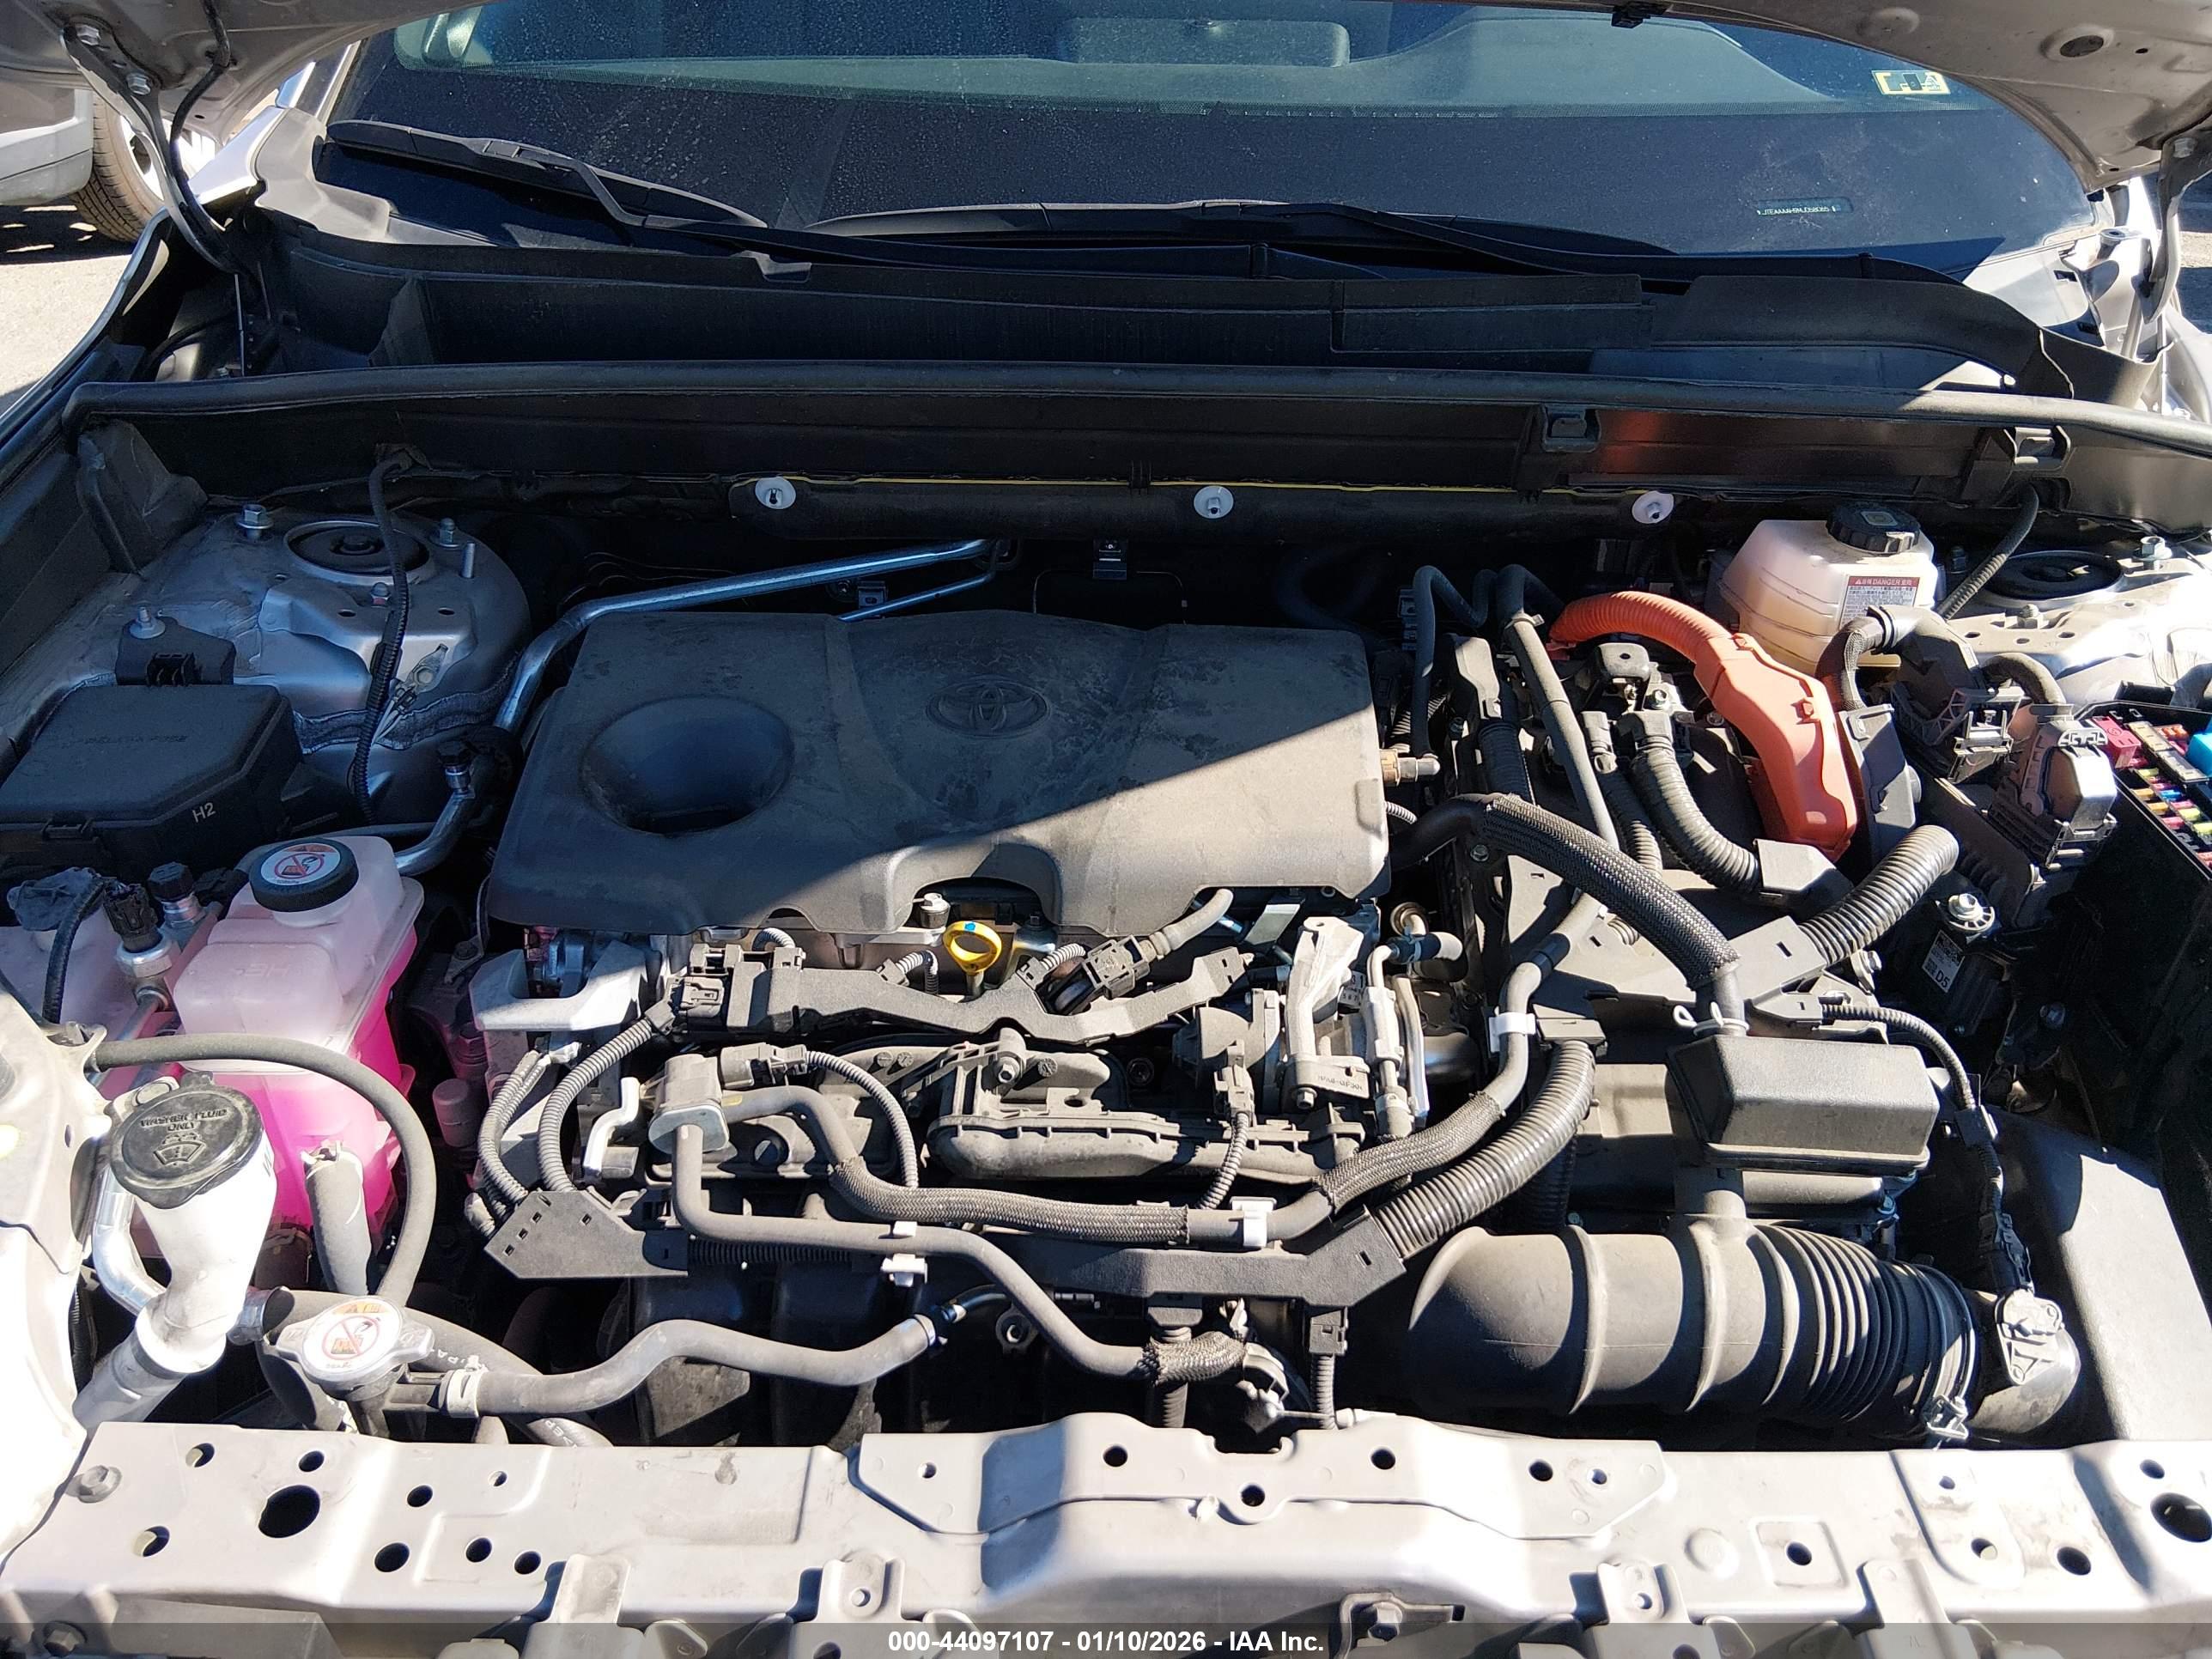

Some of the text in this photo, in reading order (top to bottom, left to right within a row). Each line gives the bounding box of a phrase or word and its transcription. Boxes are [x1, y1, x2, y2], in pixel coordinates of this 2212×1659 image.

[191, 802, 216, 823] H2
[1936, 969, 1949, 988] D5
[140, 1113, 188, 1127] WASHER
[167, 1121, 196, 1132] ONLY
